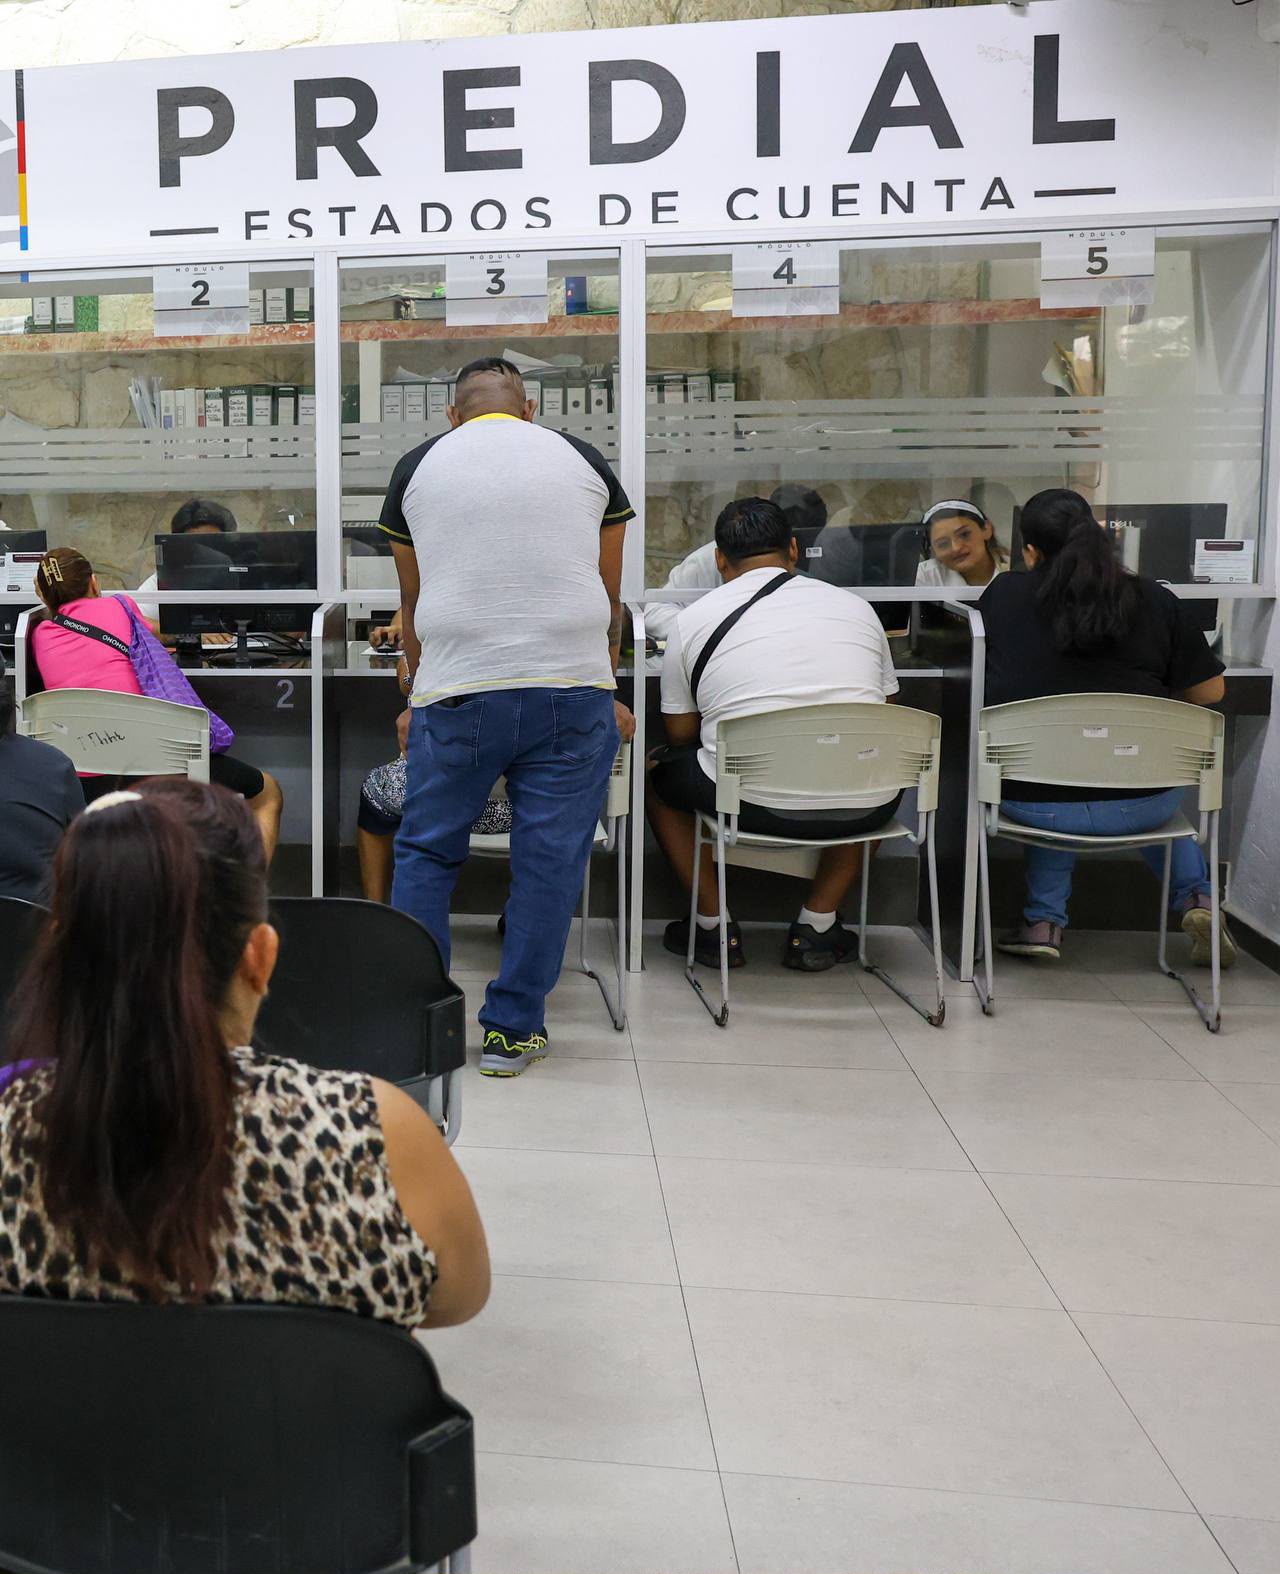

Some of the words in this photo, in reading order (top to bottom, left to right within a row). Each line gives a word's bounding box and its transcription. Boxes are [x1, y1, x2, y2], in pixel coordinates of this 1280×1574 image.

[157, 34, 1116, 188] PREDIAL
[245, 197, 552, 240] ESTADOS
[599, 191, 679, 226] DE
[726, 177, 1016, 220] CUENTA
[773, 257, 797, 285] 4
[1086, 246, 1109, 275] 5
[191, 280, 210, 306] 2
[486, 268, 506, 295] 3
[1109, 521, 1134, 529] DELL
[277, 679, 295, 708] 2
